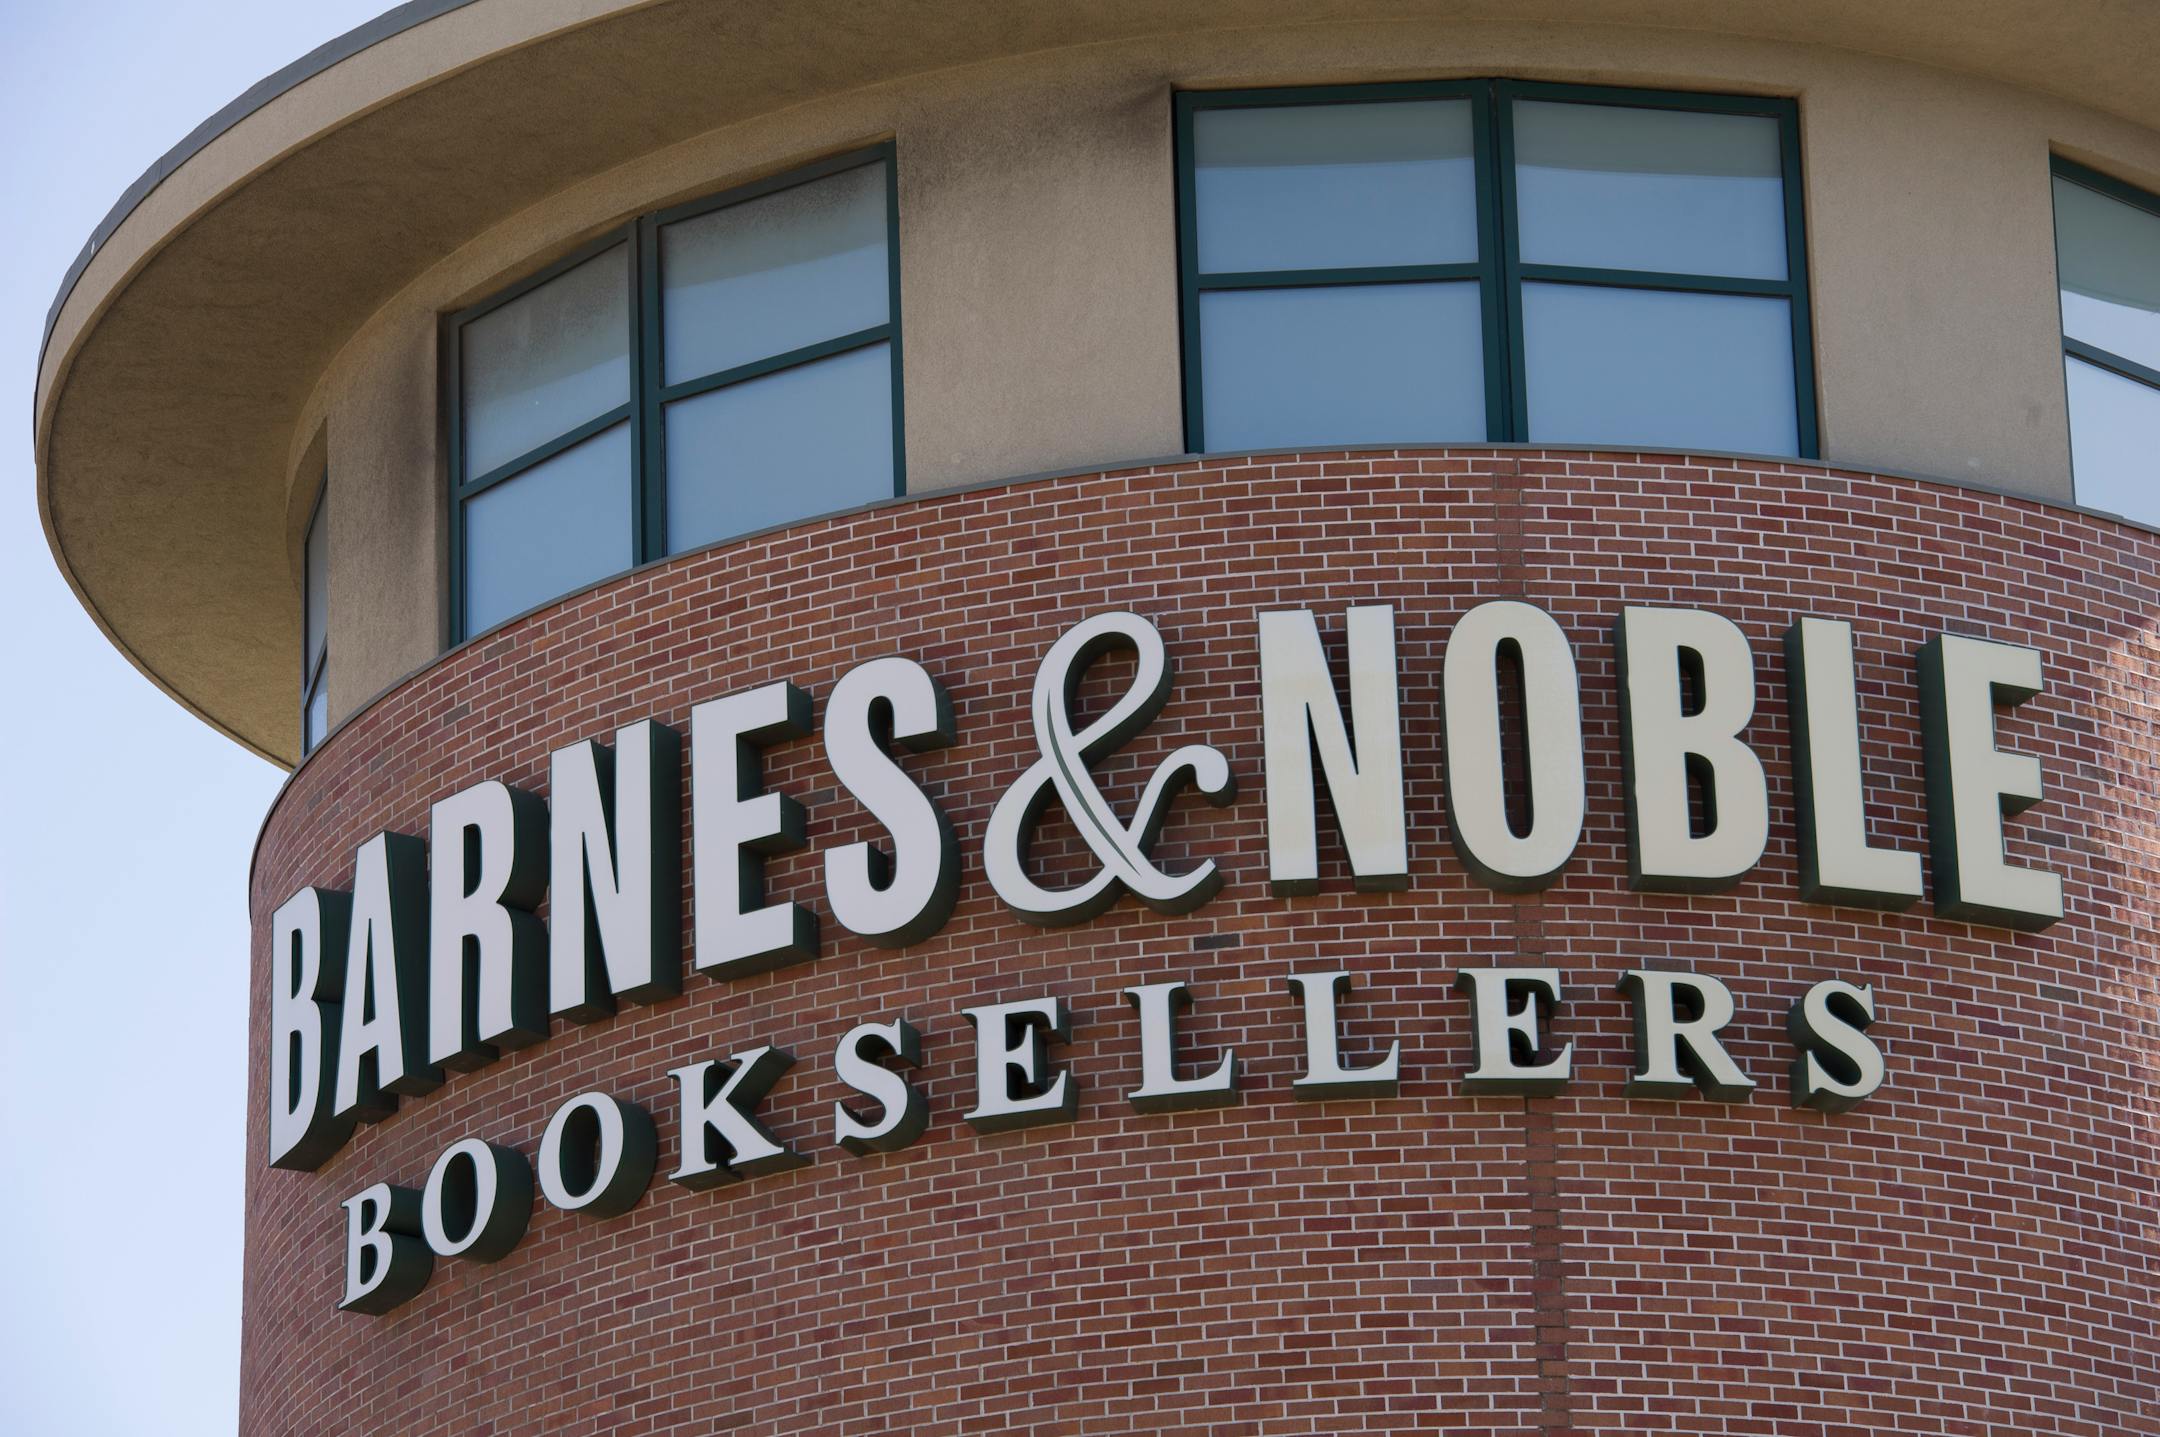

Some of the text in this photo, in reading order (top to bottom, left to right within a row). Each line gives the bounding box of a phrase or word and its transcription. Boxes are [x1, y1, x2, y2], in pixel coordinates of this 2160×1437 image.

[269, 600, 2064, 1170] BARNES & NOBLE
[339, 967, 1886, 1312] BOOKSELLERS
